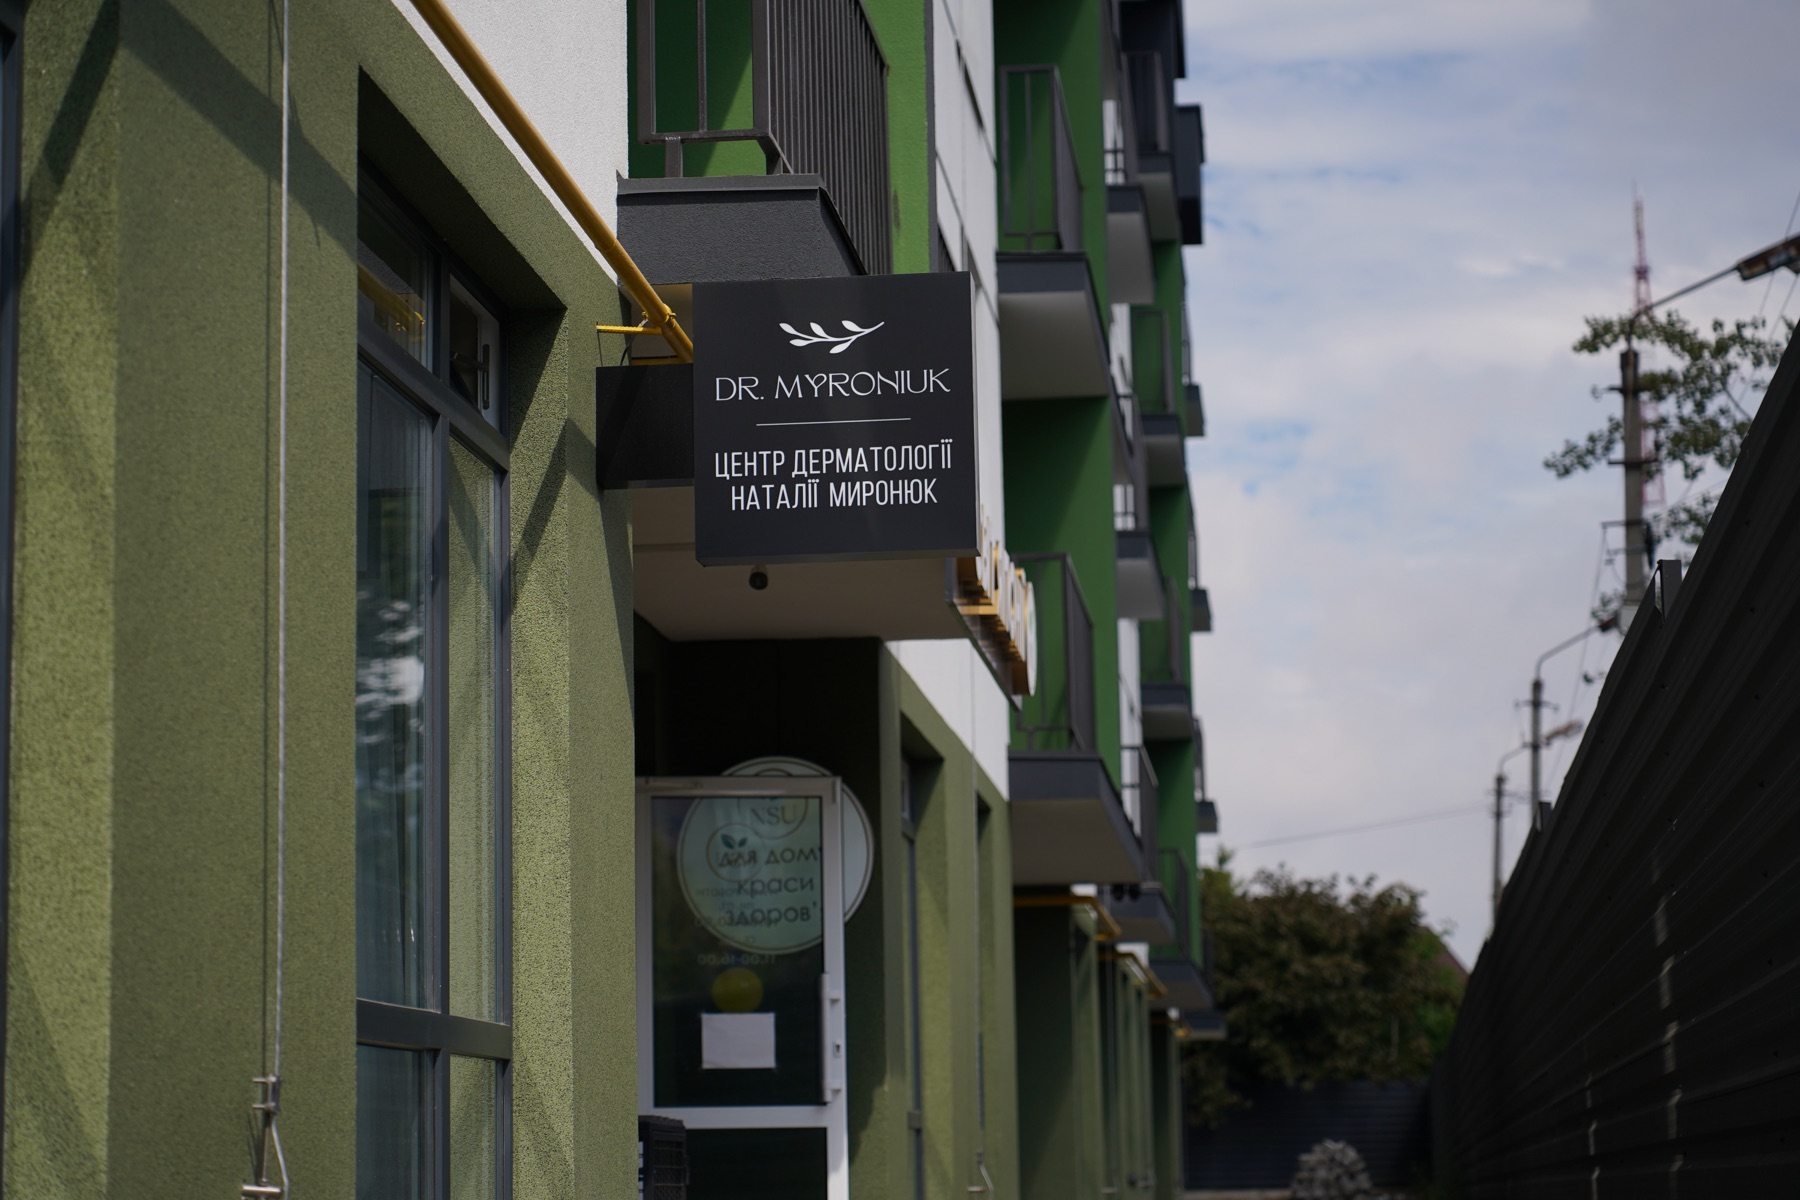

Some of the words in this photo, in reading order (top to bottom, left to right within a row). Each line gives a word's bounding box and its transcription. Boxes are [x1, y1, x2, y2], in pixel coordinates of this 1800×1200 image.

[715, 376, 765, 401] DR.
[774, 368, 951, 399] MYRONIUK
[715, 450, 786, 481] ЦЕНТР
[829, 478, 938, 508] МИРОНЮК
[764, 847, 822, 866] дом
[726, 902, 820, 928] здоров'
